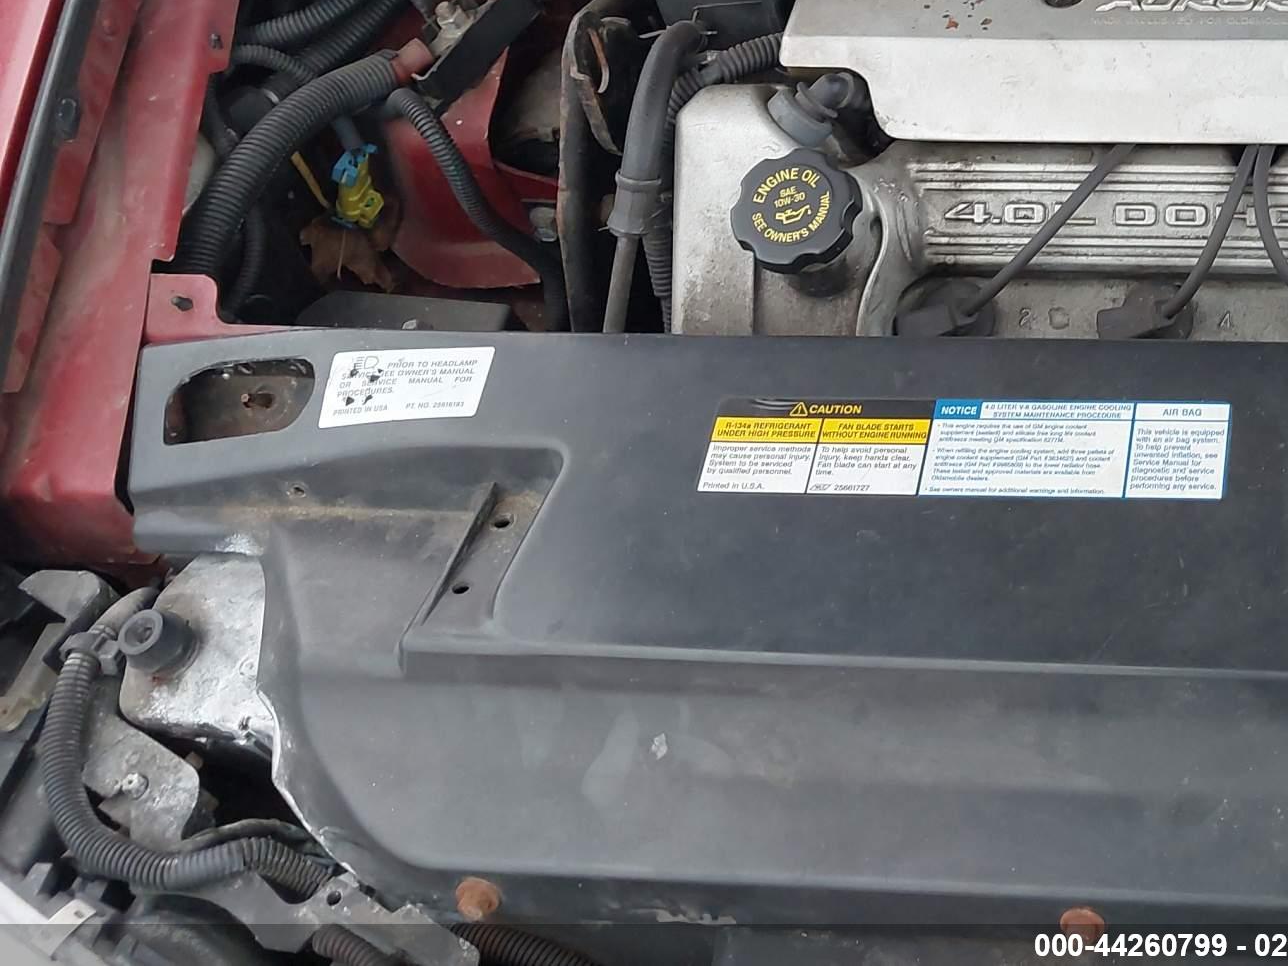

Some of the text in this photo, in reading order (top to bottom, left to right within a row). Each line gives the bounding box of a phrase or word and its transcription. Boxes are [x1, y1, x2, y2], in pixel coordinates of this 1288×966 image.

[753, 168, 820, 203] ENGINE OIL
[780, 186, 797, 197] SAE
[774, 192, 806, 208] 10W-30
[752, 191, 830, 243] SEE OWNER'S MANUAL
[1019, 308, 1033, 328] 2
[1218, 310, 1233, 330] 4
[430, 360, 478, 368] HEADLAMP
[808, 404, 864, 414] CAUTION
[941, 406, 977, 415] NOTICE
[753, 422, 812, 430] REFRIGERANT
[771, 430, 816, 438] PRESSURE
[831, 446, 849, 454] help
[843, 454, 862, 462] keep
[708, 460, 737, 468] System
[1132, 467, 1170, 475] diagnostic
[703, 481, 730, 490] Printed
[1129, 483, 1170, 491] performing
